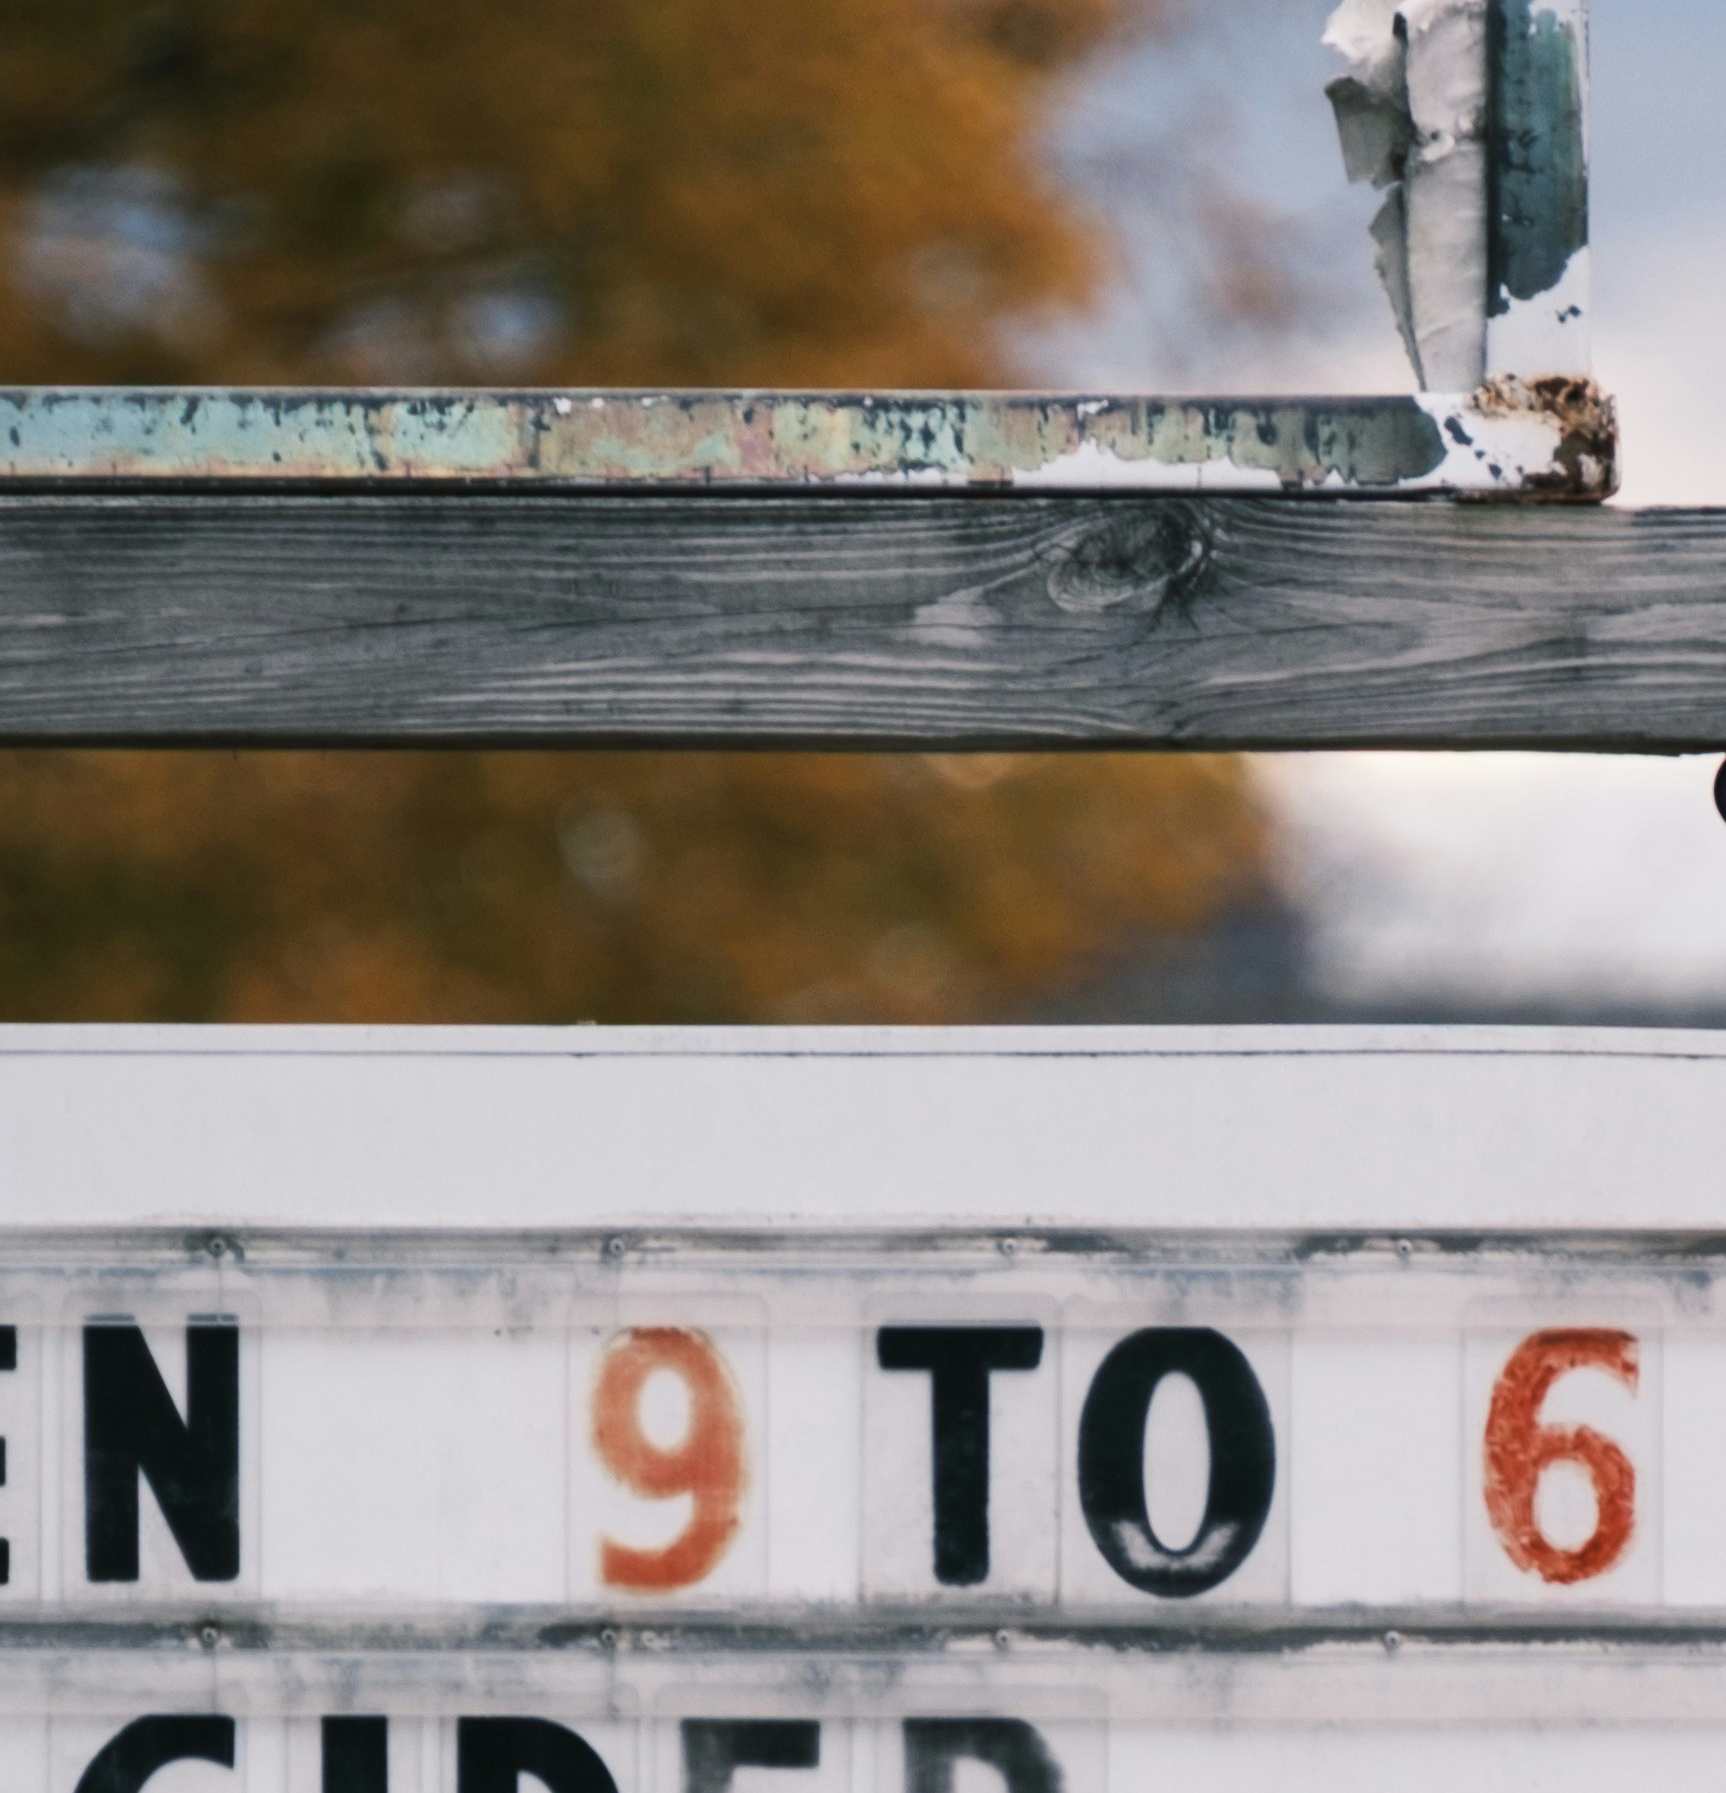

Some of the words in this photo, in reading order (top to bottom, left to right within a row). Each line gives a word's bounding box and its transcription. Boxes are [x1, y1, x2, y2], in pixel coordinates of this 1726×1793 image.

[589, 1324, 753, 1593] 9
[876, 1323, 1276, 1599] TO
[1483, 1326, 1640, 1586] 6
